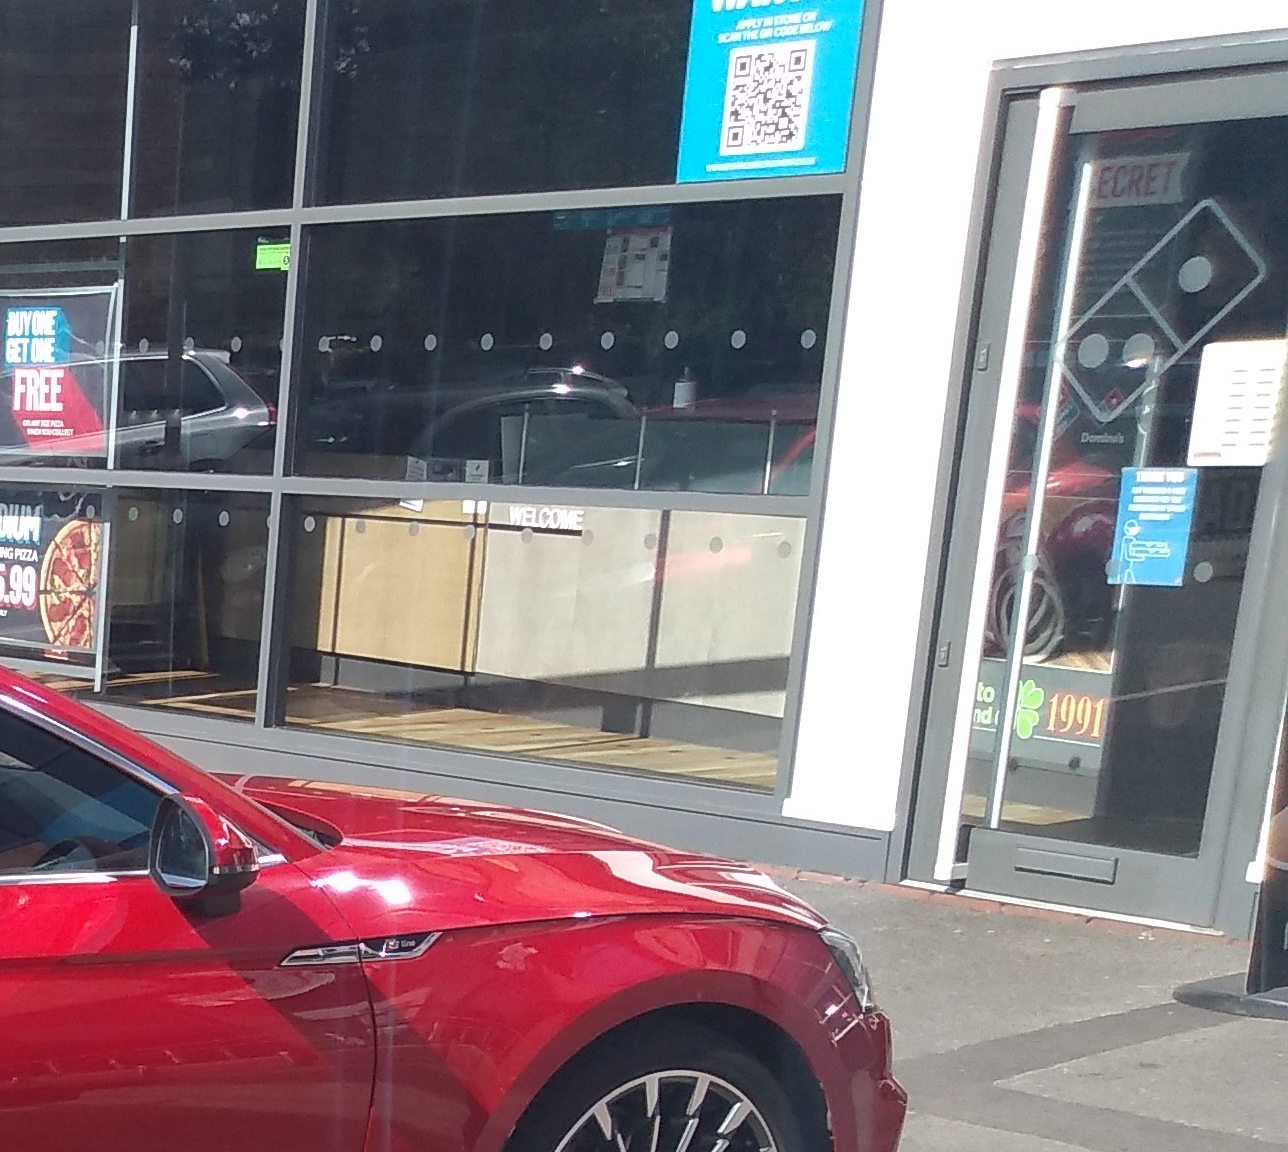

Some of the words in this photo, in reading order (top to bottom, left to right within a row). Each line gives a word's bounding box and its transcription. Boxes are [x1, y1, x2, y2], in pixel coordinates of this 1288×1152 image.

[736, 18, 763, 30] APPLY
[774, 13, 802, 26] STORE
[717, 32, 742, 43] SCAN
[1097, 161, 1178, 199] ECRET
[6, 310, 32, 336] BUY
[32, 310, 57, 336] ONE
[6, 338, 30, 364] GET
[30, 338, 55, 364] ONE
[13, 368, 64, 412] FREE
[509, 505, 584, 530] WELCOME
[15, 549, 38, 562] PIZZA
[1046, 692, 1105, 738] 1991
